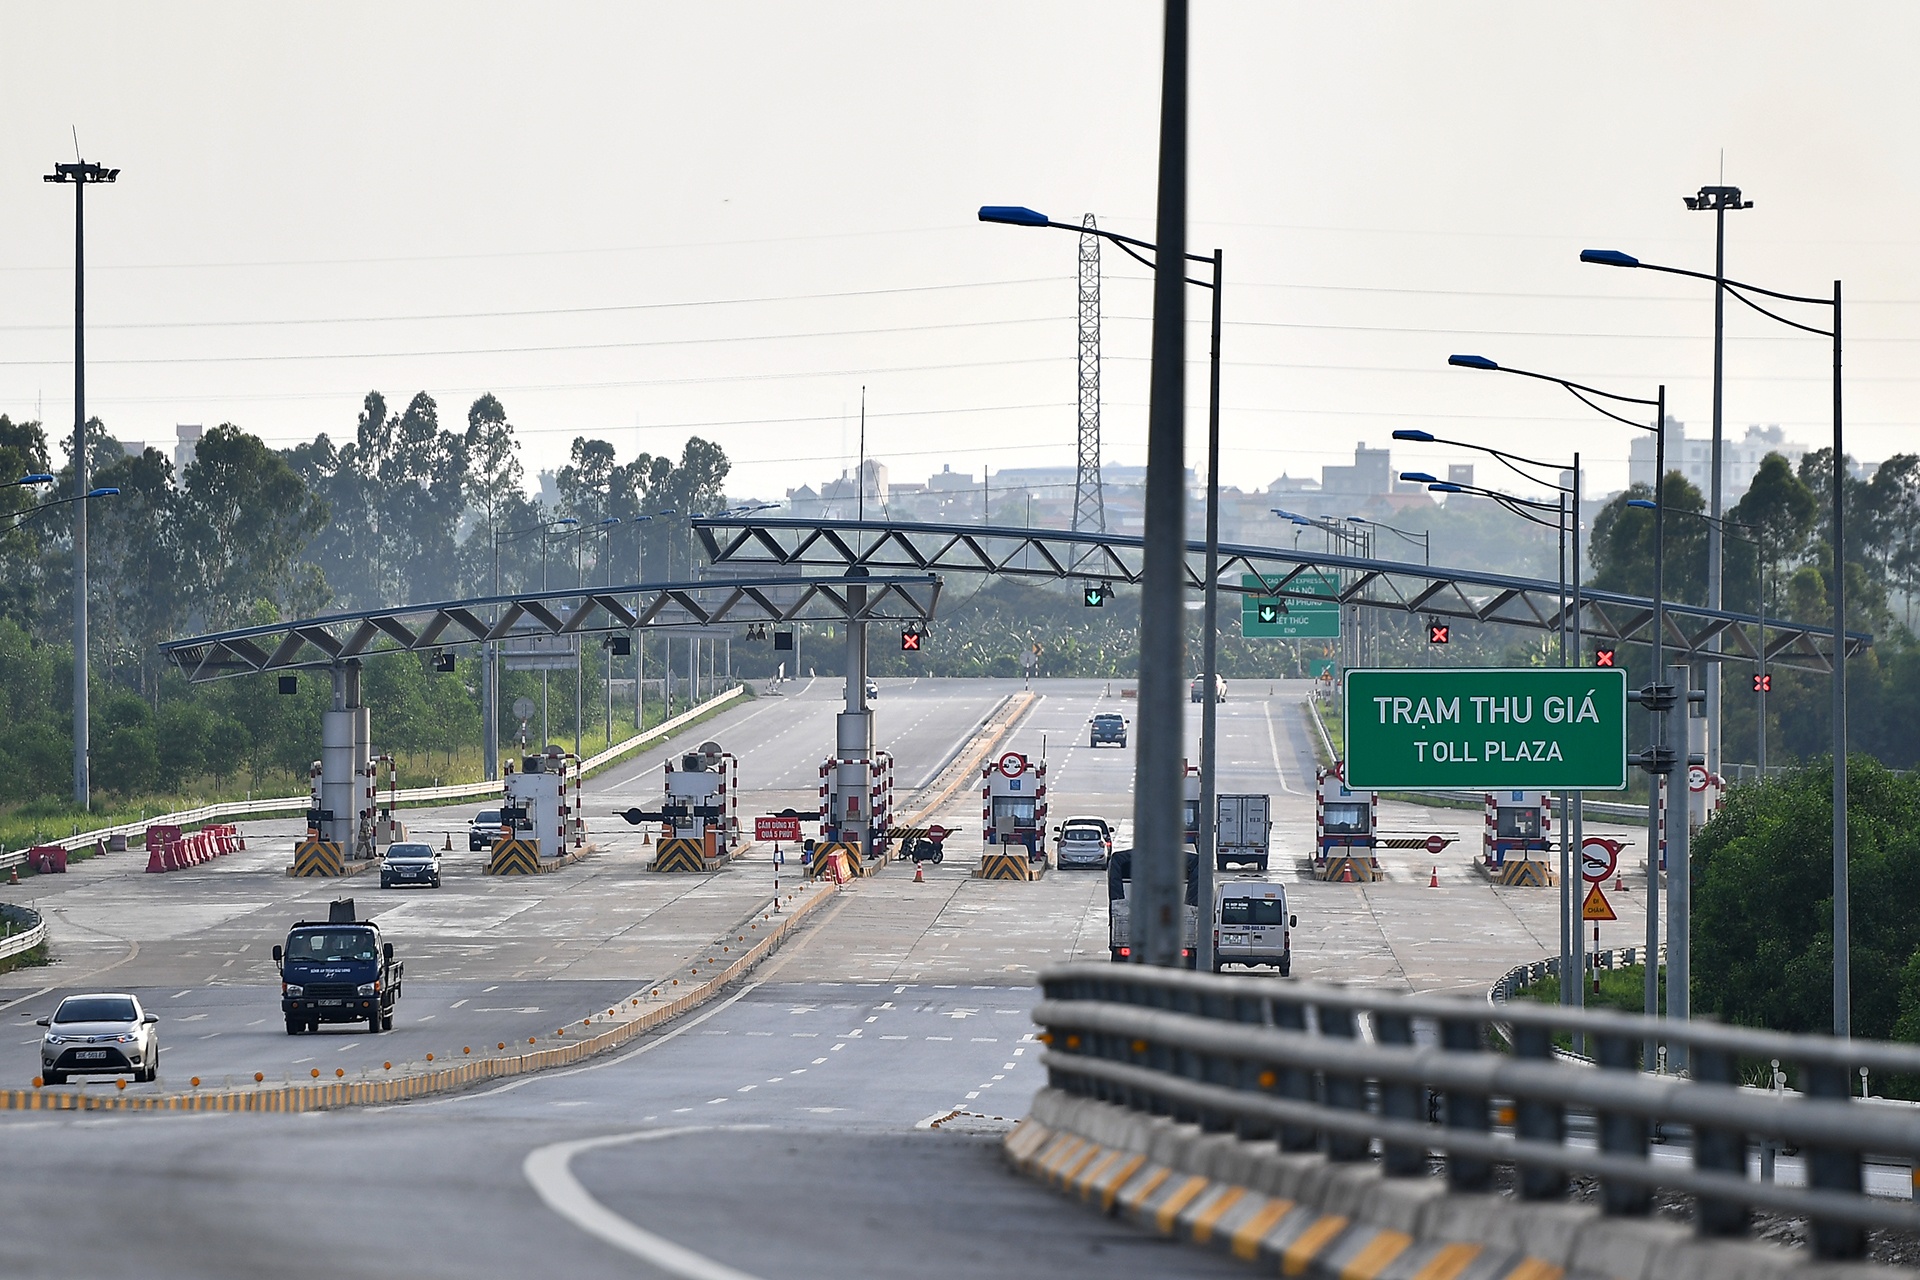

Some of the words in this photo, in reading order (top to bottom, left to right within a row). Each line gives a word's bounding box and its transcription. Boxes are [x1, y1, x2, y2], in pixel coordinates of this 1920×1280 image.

[1373, 697, 1460, 729] TRẠM
[1470, 696, 1532, 724] THU
[1543, 689, 1600, 724] GIÁ
[1413, 741, 1478, 762] TOLL
[1485, 741, 1563, 762] PLAZA
[788, 821, 795, 829] XE
[774, 830, 778, 838] 5
